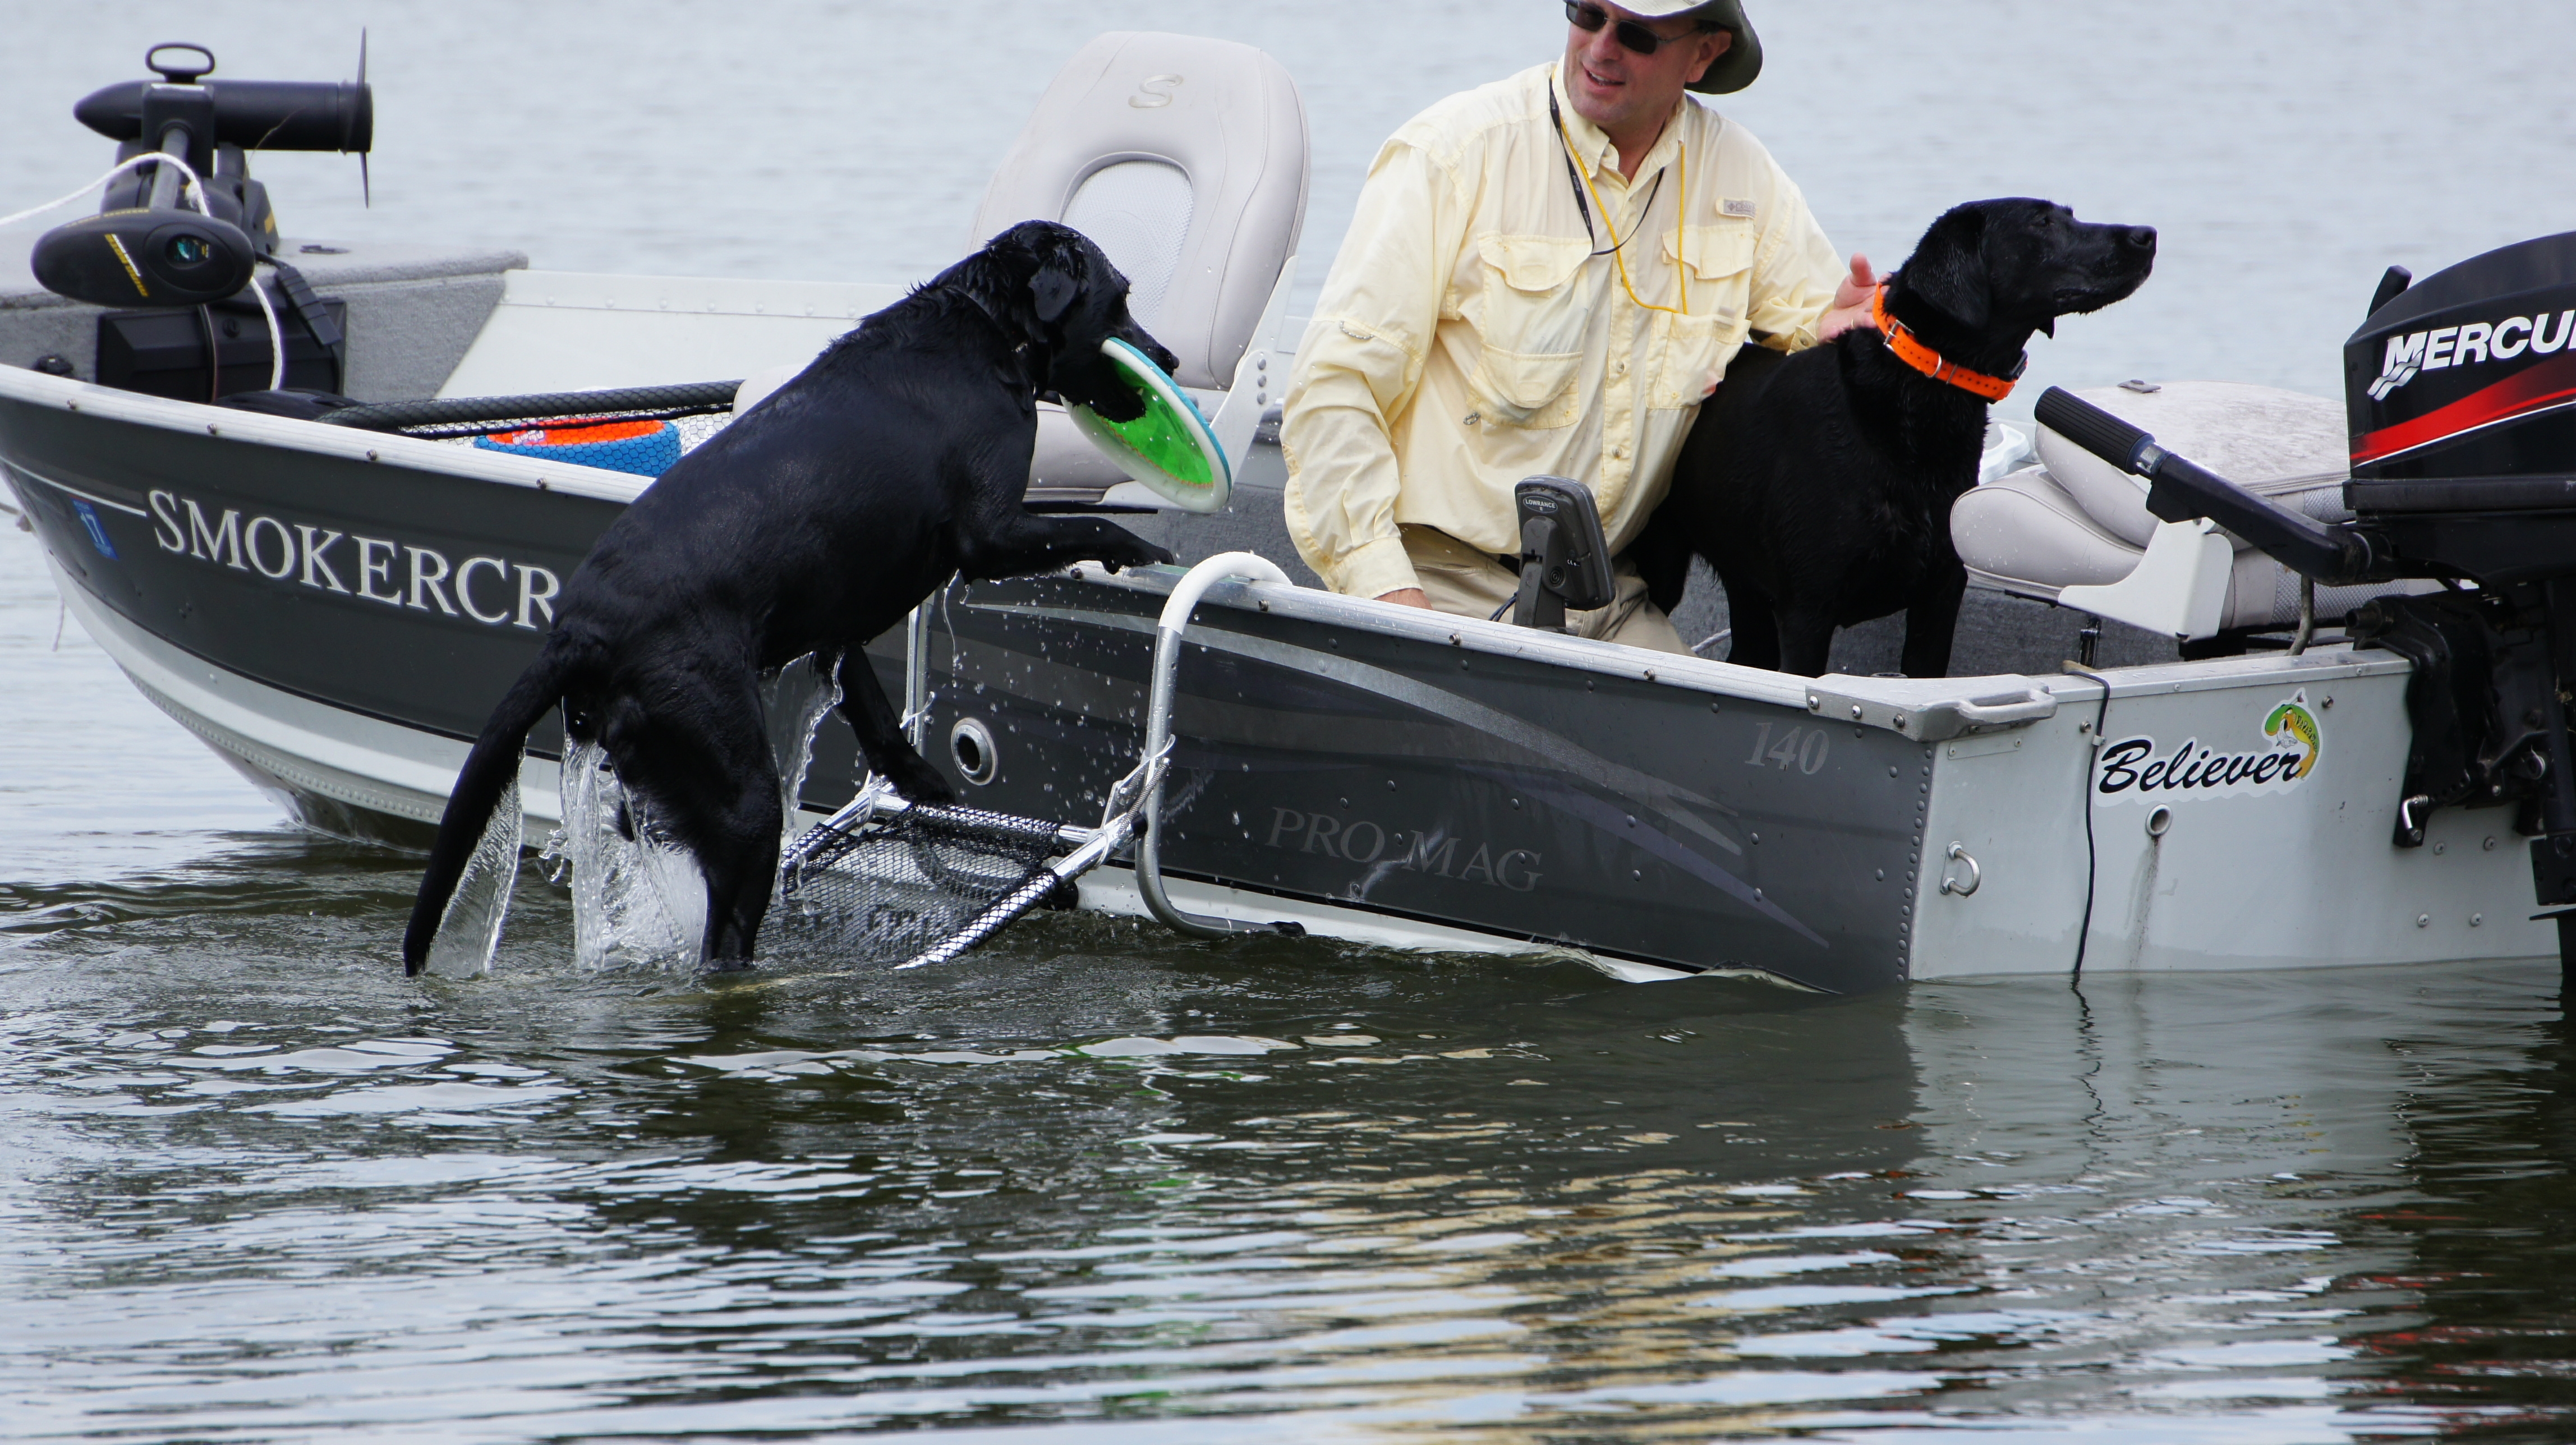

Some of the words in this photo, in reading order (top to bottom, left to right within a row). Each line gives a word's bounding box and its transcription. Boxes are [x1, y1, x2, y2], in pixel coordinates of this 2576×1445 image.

[2382, 310, 2576, 377] MERCU
[80, 512, 105, 545] 17
[1525, 498, 1556, 508] LOWRANCE
[149, 490, 559, 629] SMOKERCR
[1745, 722, 1829, 775] 140
[2099, 739, 2302, 793] Believer
[1265, 807, 1385, 863] PRO
[1402, 830, 1543, 892] MAG
